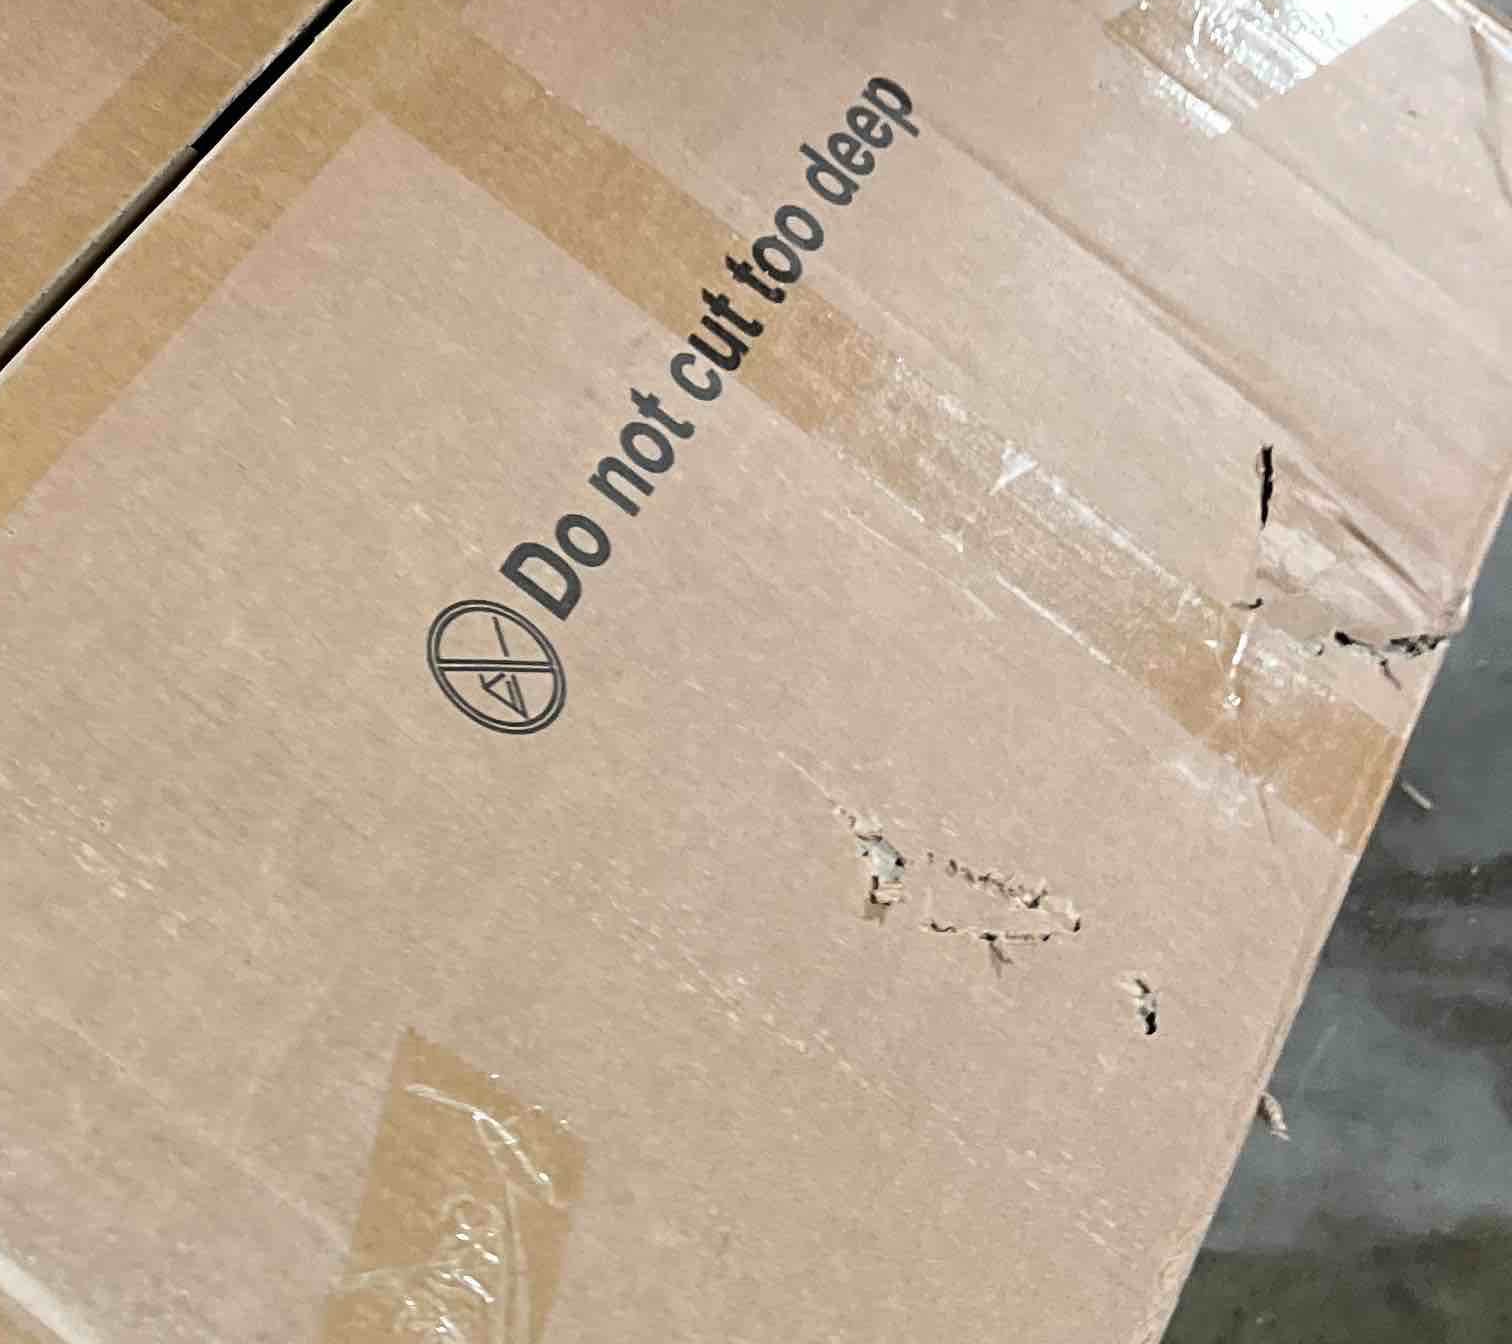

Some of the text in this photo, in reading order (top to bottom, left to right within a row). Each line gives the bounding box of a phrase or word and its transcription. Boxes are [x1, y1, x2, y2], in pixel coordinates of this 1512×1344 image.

[498, 74, 921, 623] Do not cut too deep
